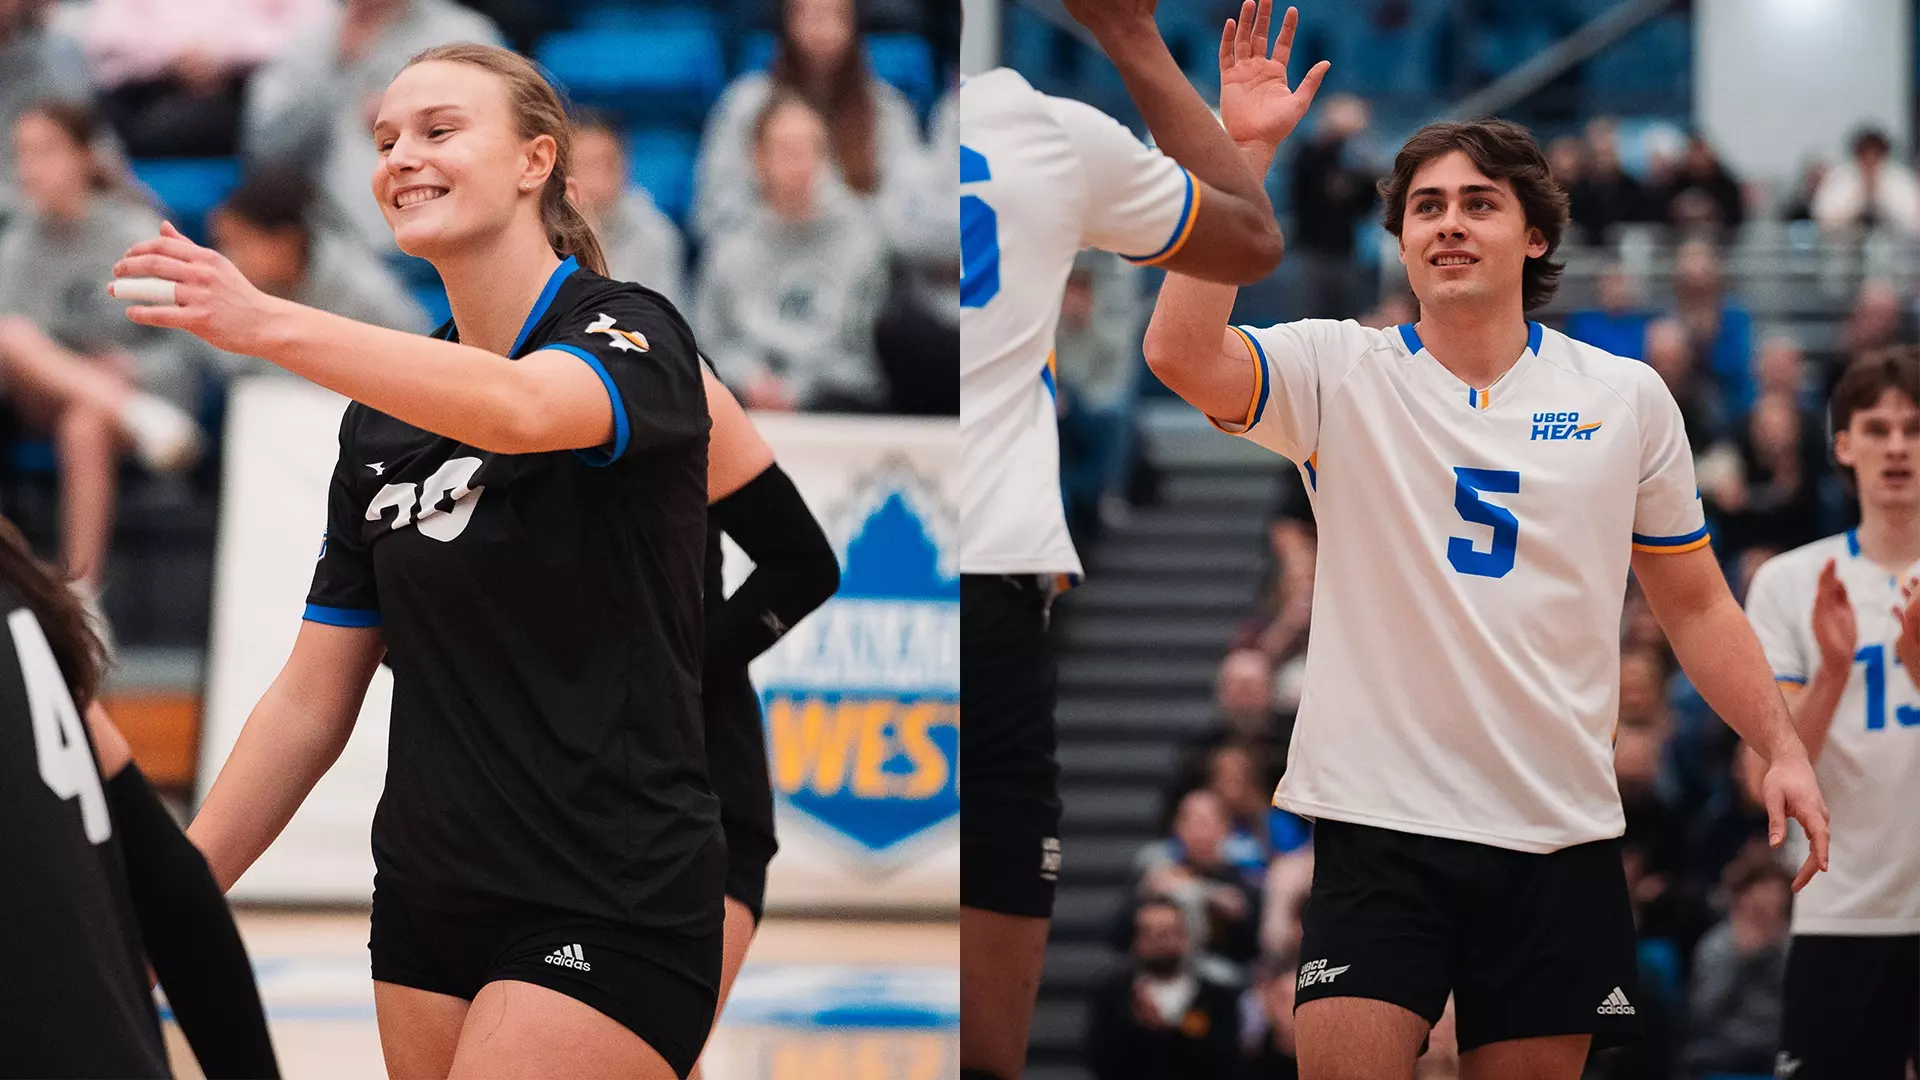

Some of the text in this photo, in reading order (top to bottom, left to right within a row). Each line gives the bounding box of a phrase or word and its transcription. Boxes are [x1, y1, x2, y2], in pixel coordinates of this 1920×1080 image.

[1532, 412, 1580, 423] UBCO
[1530, 421, 1603, 441] HEAT
[1446, 466, 1521, 579] 5
[7, 607, 112, 845] 4
[772, 699, 960, 799] WES
[544, 954, 591, 972] adidas
[1297, 964, 1351, 991] HEAT
[1596, 1004, 1636, 1015] adidas
